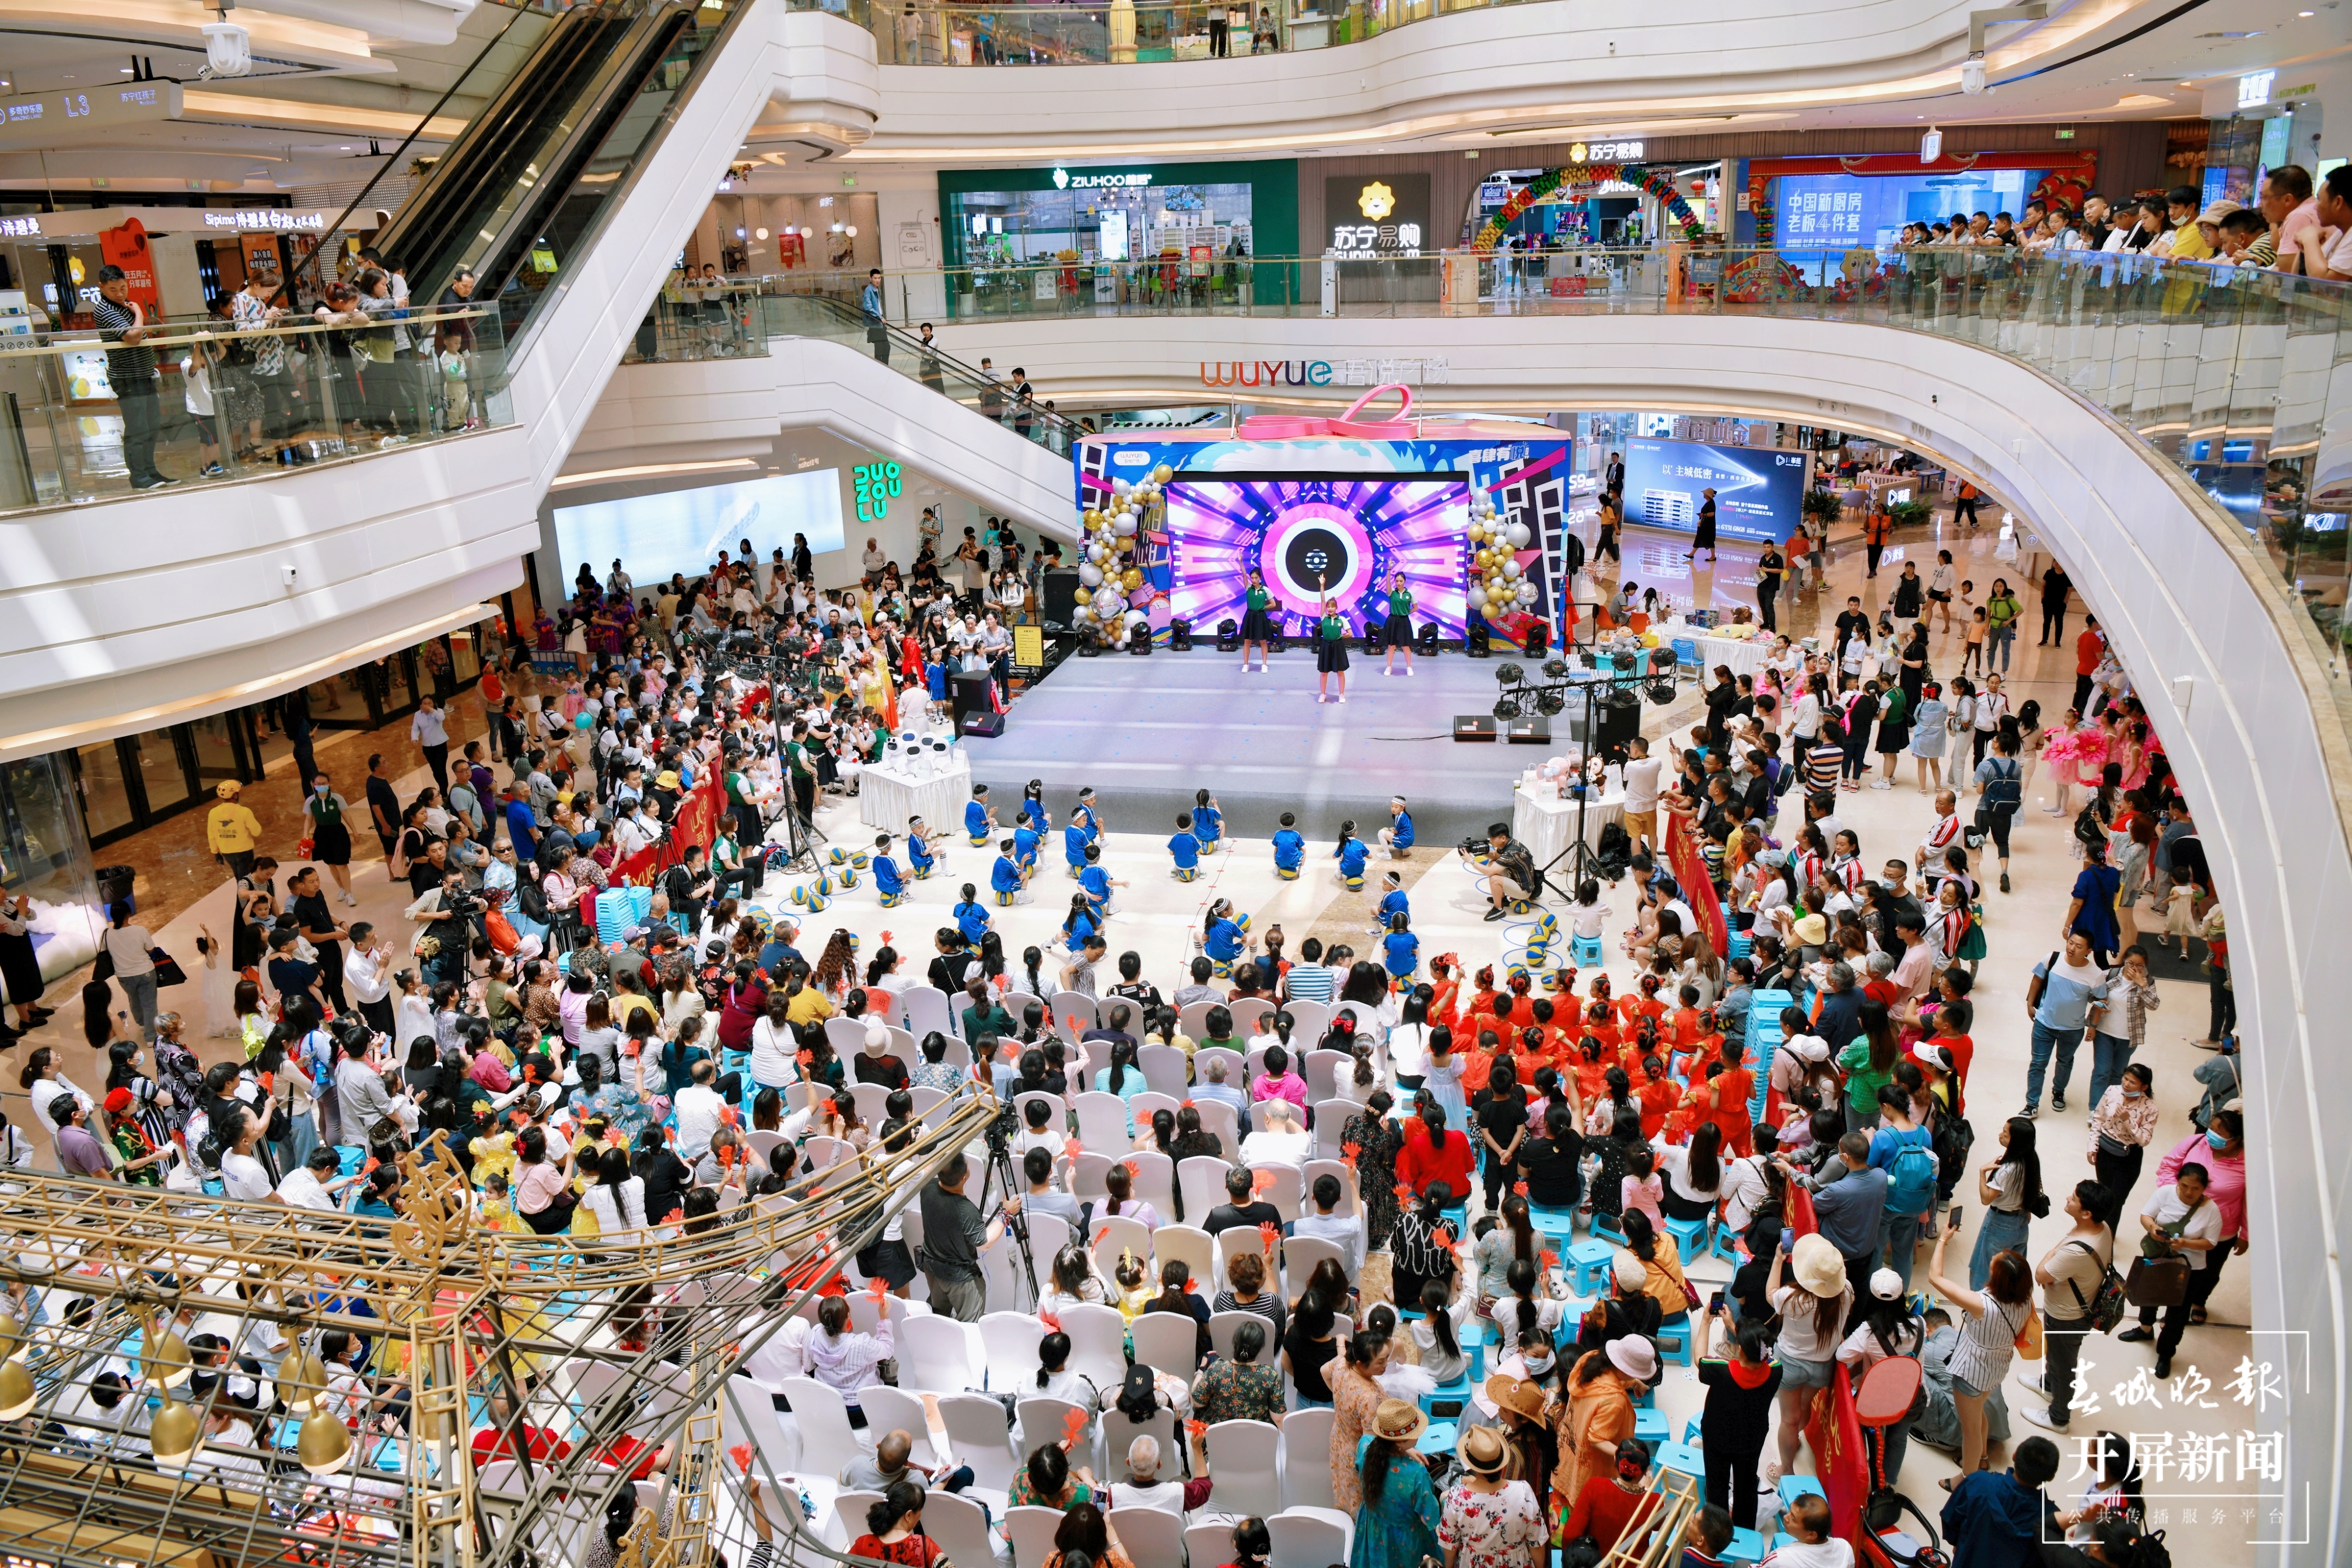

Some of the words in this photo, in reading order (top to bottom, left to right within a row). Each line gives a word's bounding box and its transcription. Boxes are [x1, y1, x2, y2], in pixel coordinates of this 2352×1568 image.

[121, 90, 156, 102] 苏宁红孩子
[9, 104, 43, 116] 多奇妙乐园
[65, 95, 90, 117] L3
[1590, 142, 1643, 160] 苏宁易购
[1072, 175, 1125, 188] ZIUHOO
[1788, 191, 1862, 212] 中国新厨房
[2, 217, 41, 237] 诗碧曼
[204, 214, 236, 227] Sipimo
[235, 211, 269, 228] 诗碧曼
[1787, 212, 1860, 233] 老板4件套
[1334, 223, 1420, 249] 苏宁易购
[253, 250, 272, 258] 加入会员
[124, 270, 141, 279] 在五月
[129, 279, 152, 288] 分享喜悦
[1344, 356, 1449, 386] 吾悦广场
[1675, 466, 1712, 480] 主城低密
[855, 479, 902, 505] ZOU
[856, 500, 887, 522] LU
[870, 998, 887, 1007] 一班
